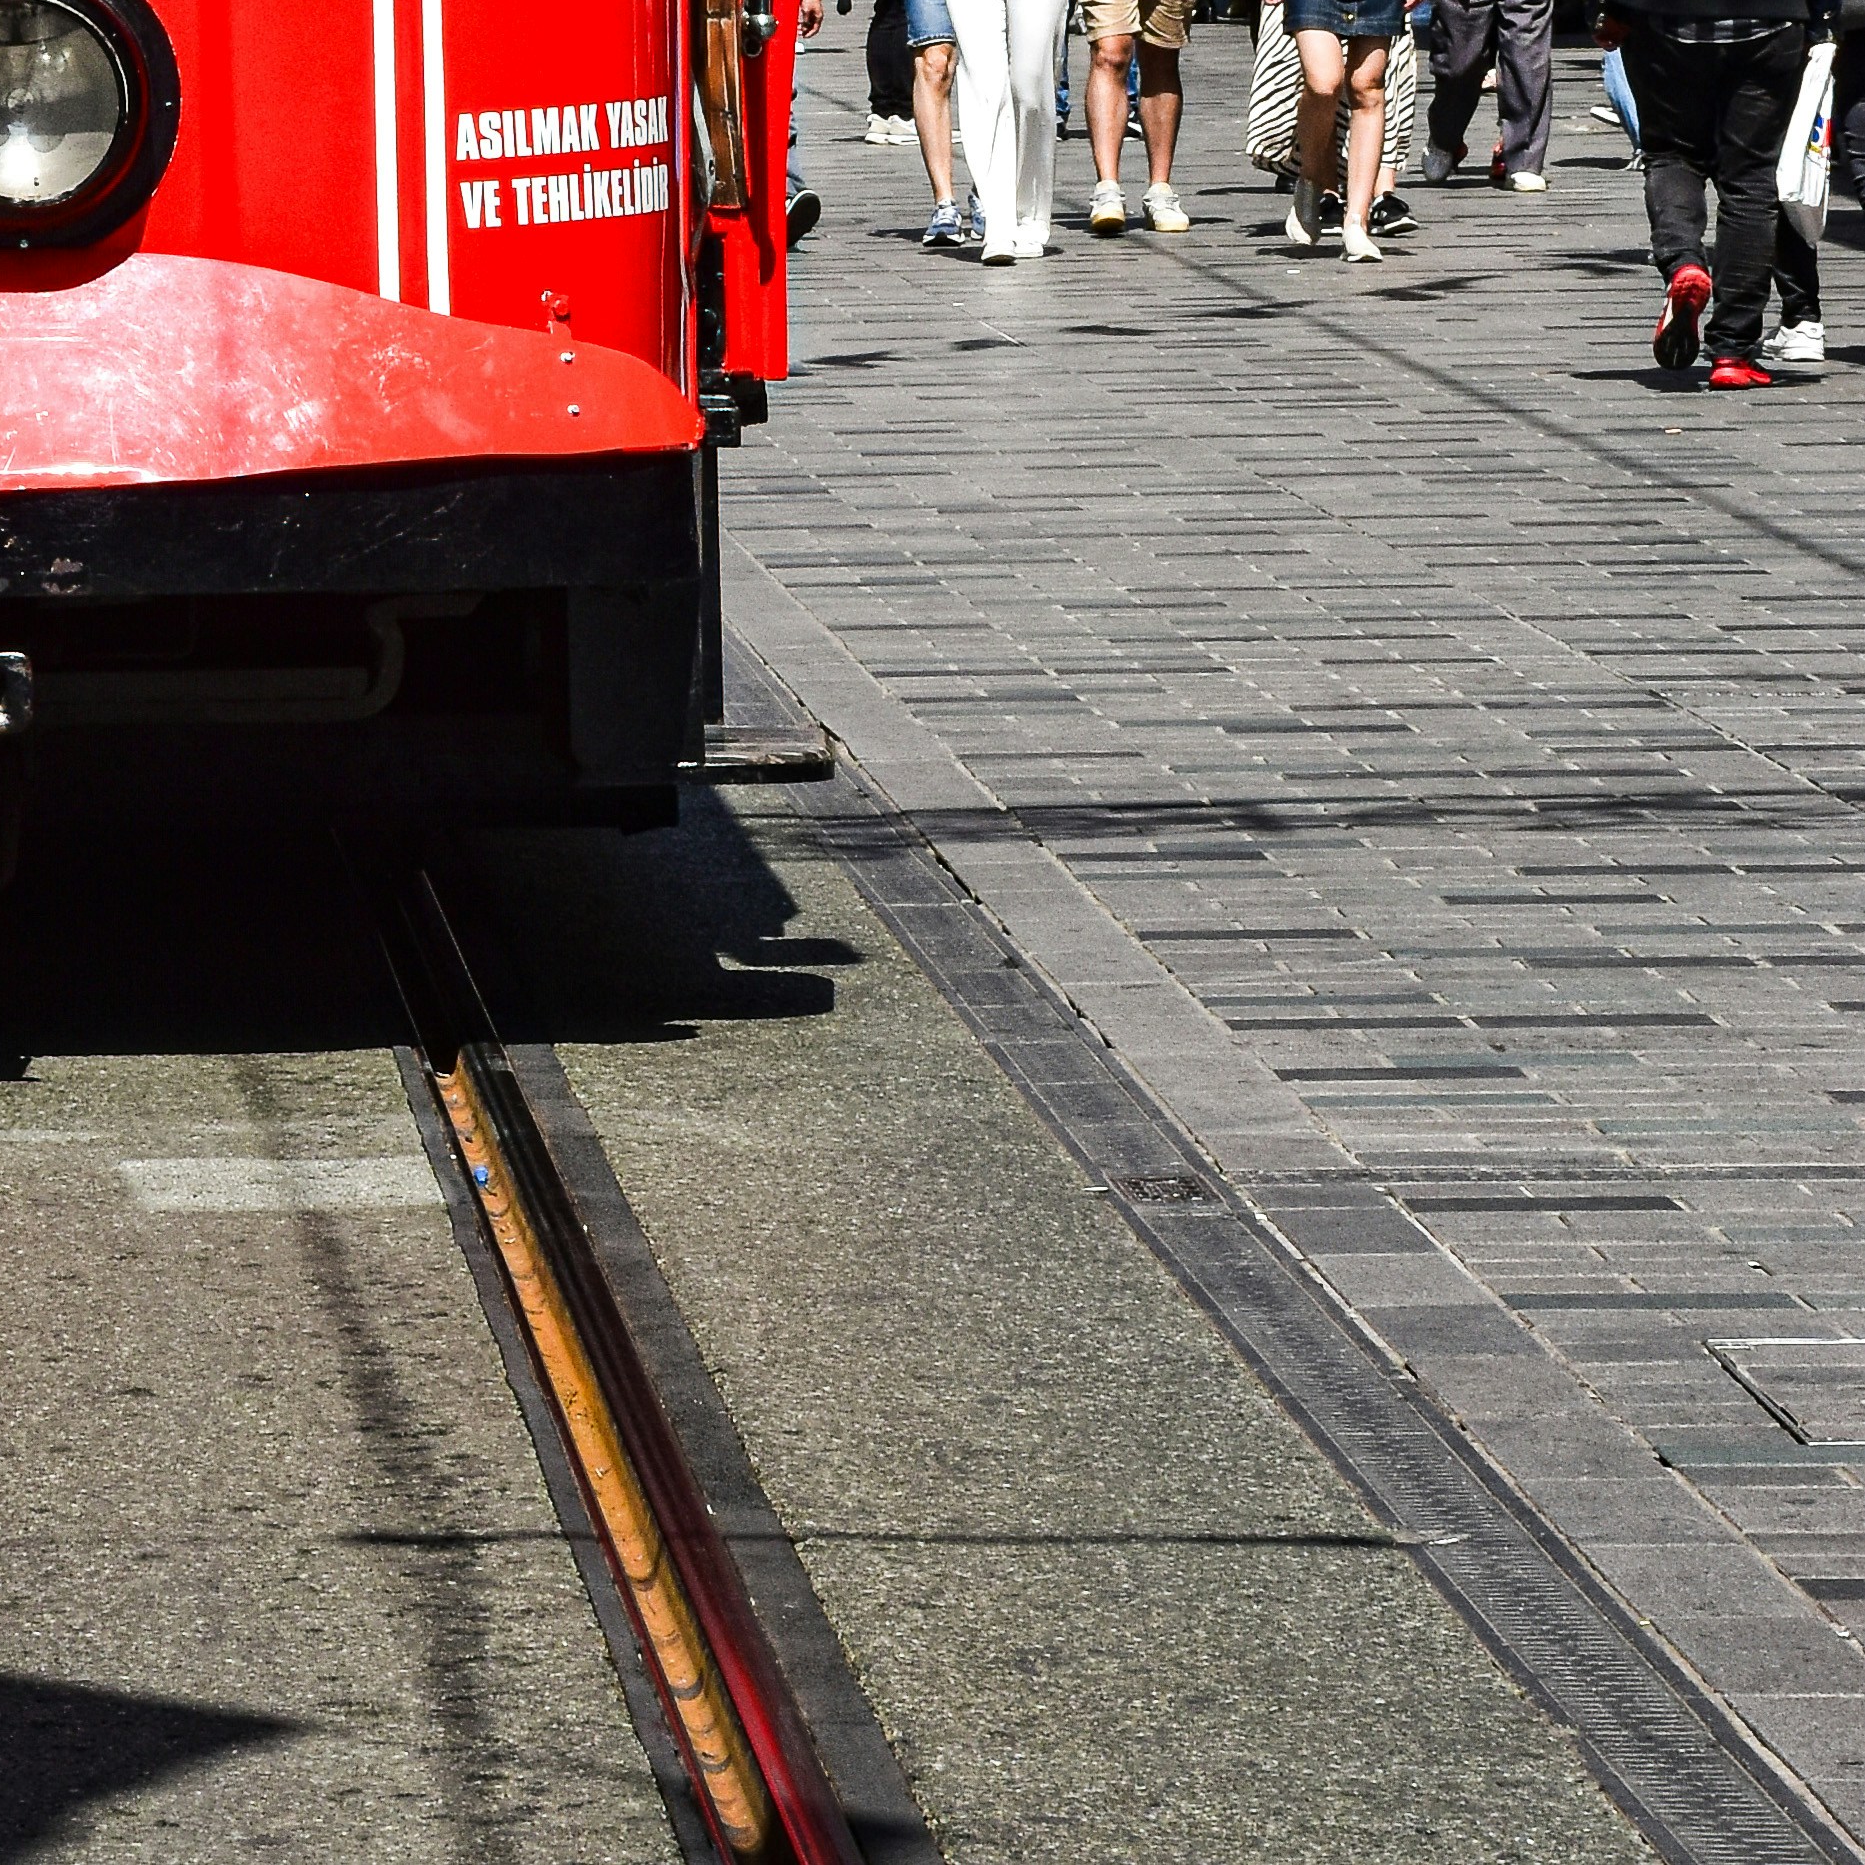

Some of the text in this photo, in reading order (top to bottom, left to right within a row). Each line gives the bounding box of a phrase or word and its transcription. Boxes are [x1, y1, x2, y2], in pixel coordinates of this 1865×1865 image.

[455, 95, 669, 161] ASILMAK YASAK
[459, 156, 670, 229] VE TEHLİKELİDİR
